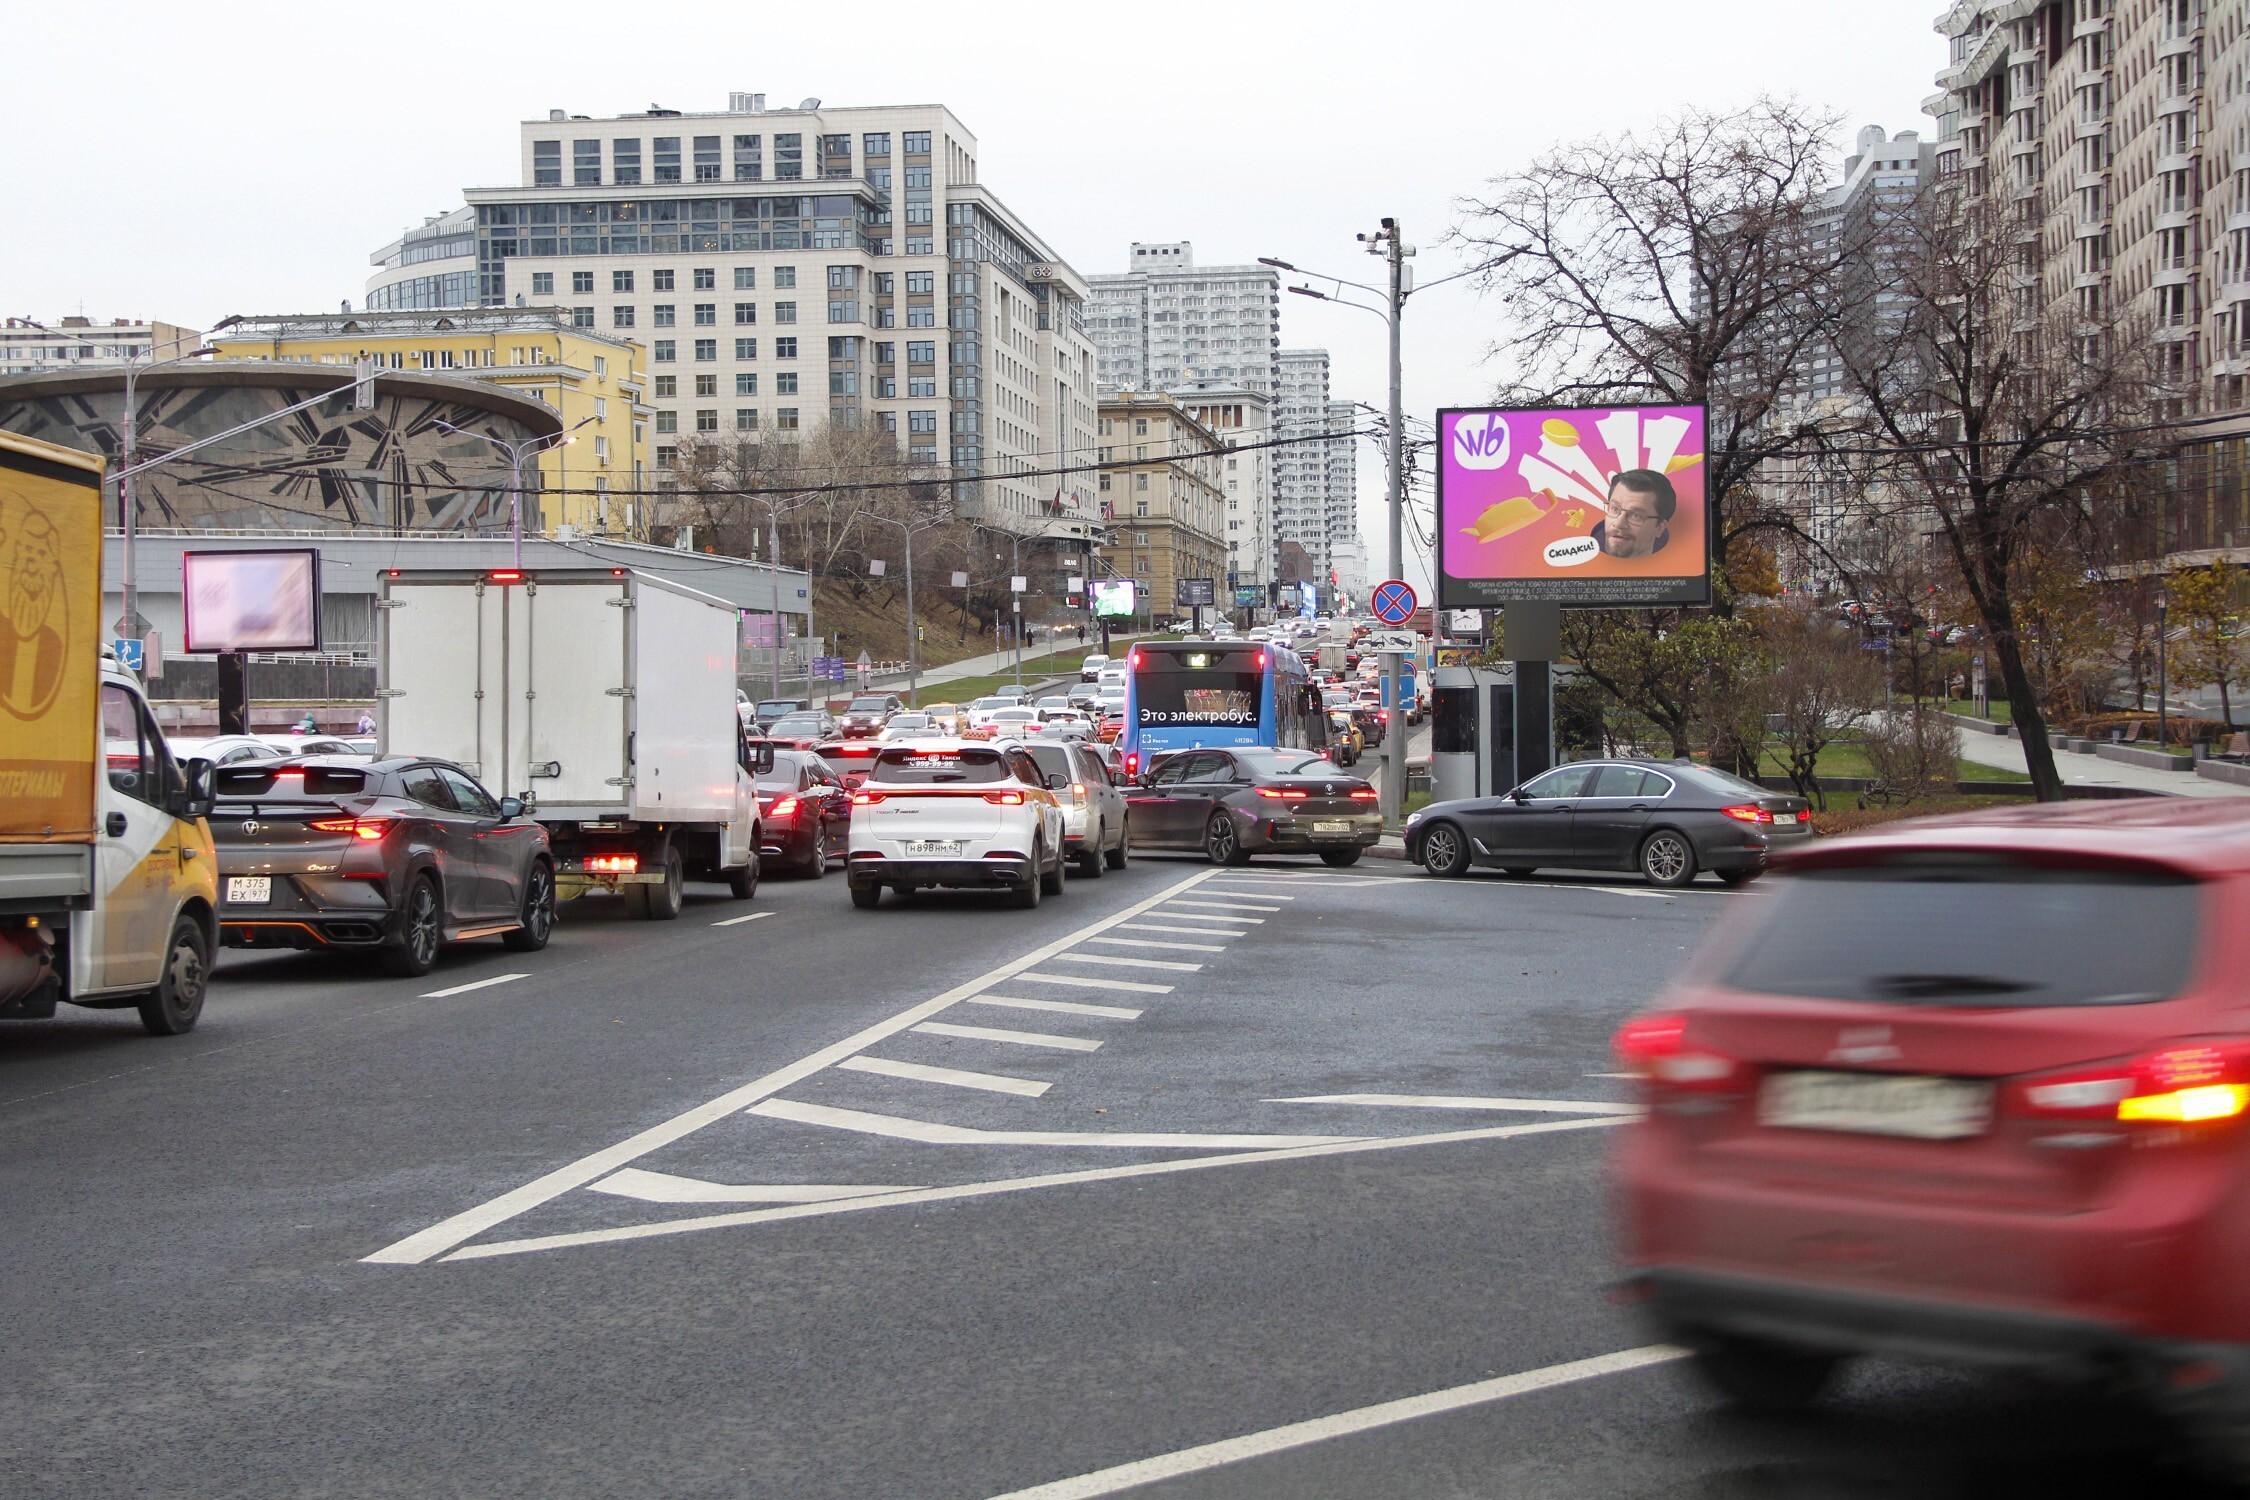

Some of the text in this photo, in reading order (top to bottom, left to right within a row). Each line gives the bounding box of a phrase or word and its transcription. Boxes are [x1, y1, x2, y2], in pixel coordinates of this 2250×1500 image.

[1548, 541, 1595, 558] Скидки!
[1140, 708, 1257, 724] Это электробус.
[233, 878, 266, 888] М 375
[230, 889, 268, 900] ЕХ 977
